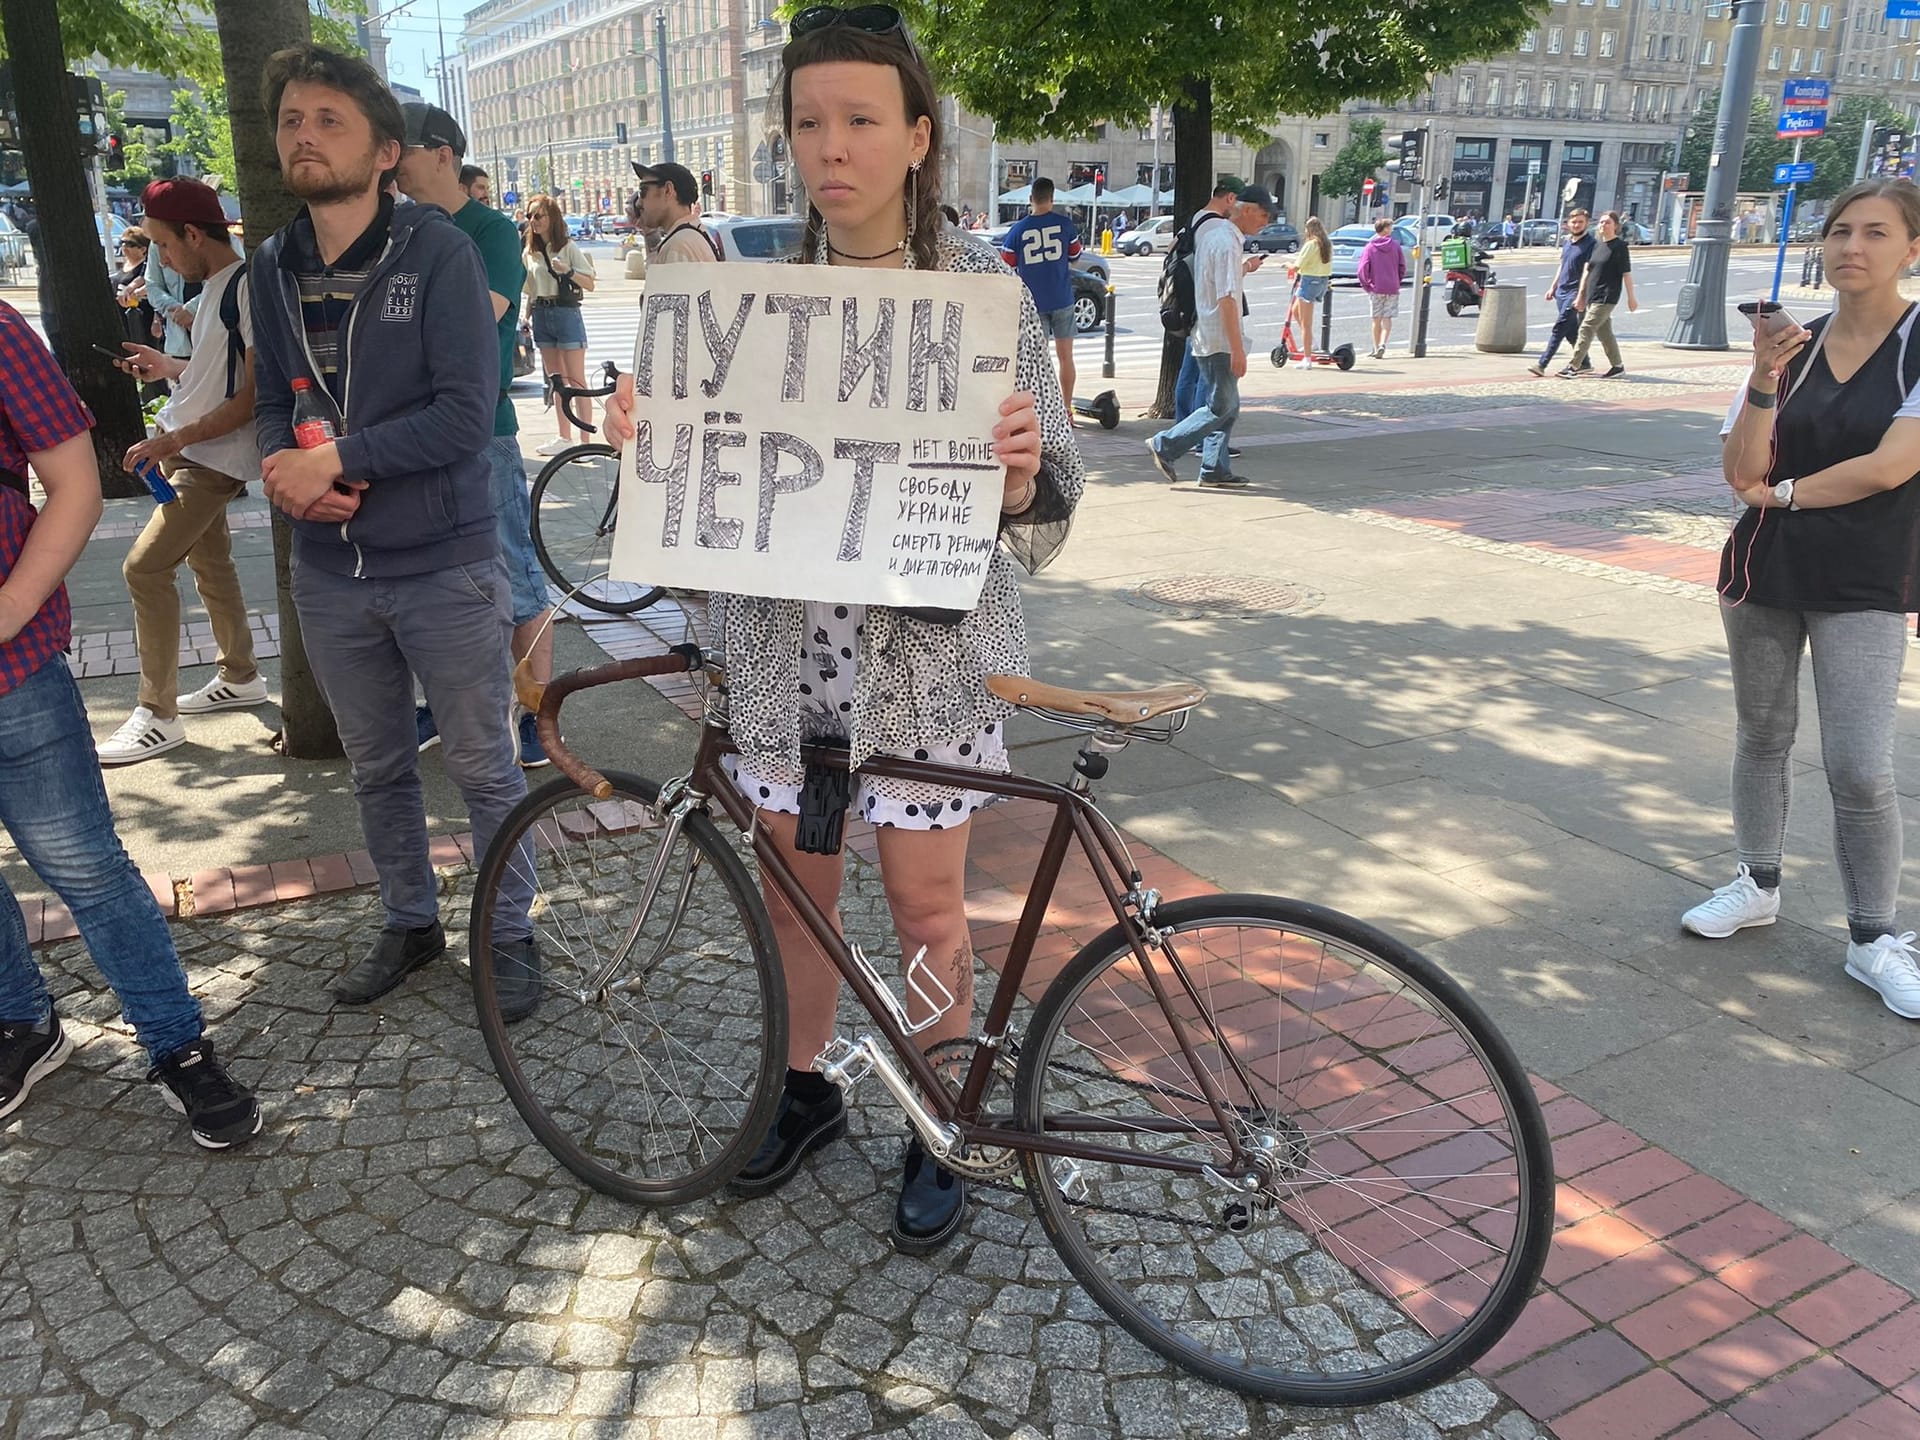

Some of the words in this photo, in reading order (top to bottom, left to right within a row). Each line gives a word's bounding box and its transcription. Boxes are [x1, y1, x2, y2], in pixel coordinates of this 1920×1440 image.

[1022, 225, 1062, 265] 25
[387, 297, 415, 305] ELES
[390, 286, 416, 295] ANG
[912, 438, 943, 460] НЕТ
[949, 437, 994, 461] ВОЙНЕ
[636, 412, 900, 562] ЧЁРТ
[899, 476, 972, 504] СВОБОДУ
[897, 499, 973, 524] УКРАИНЕ
[892, 533, 941, 553] СМЕРТЬ
[947, 535, 994, 560] РЕЖИМУ
[888, 557, 898, 570] И
[899, 557, 982, 578] ДИКТАТОРАМ
